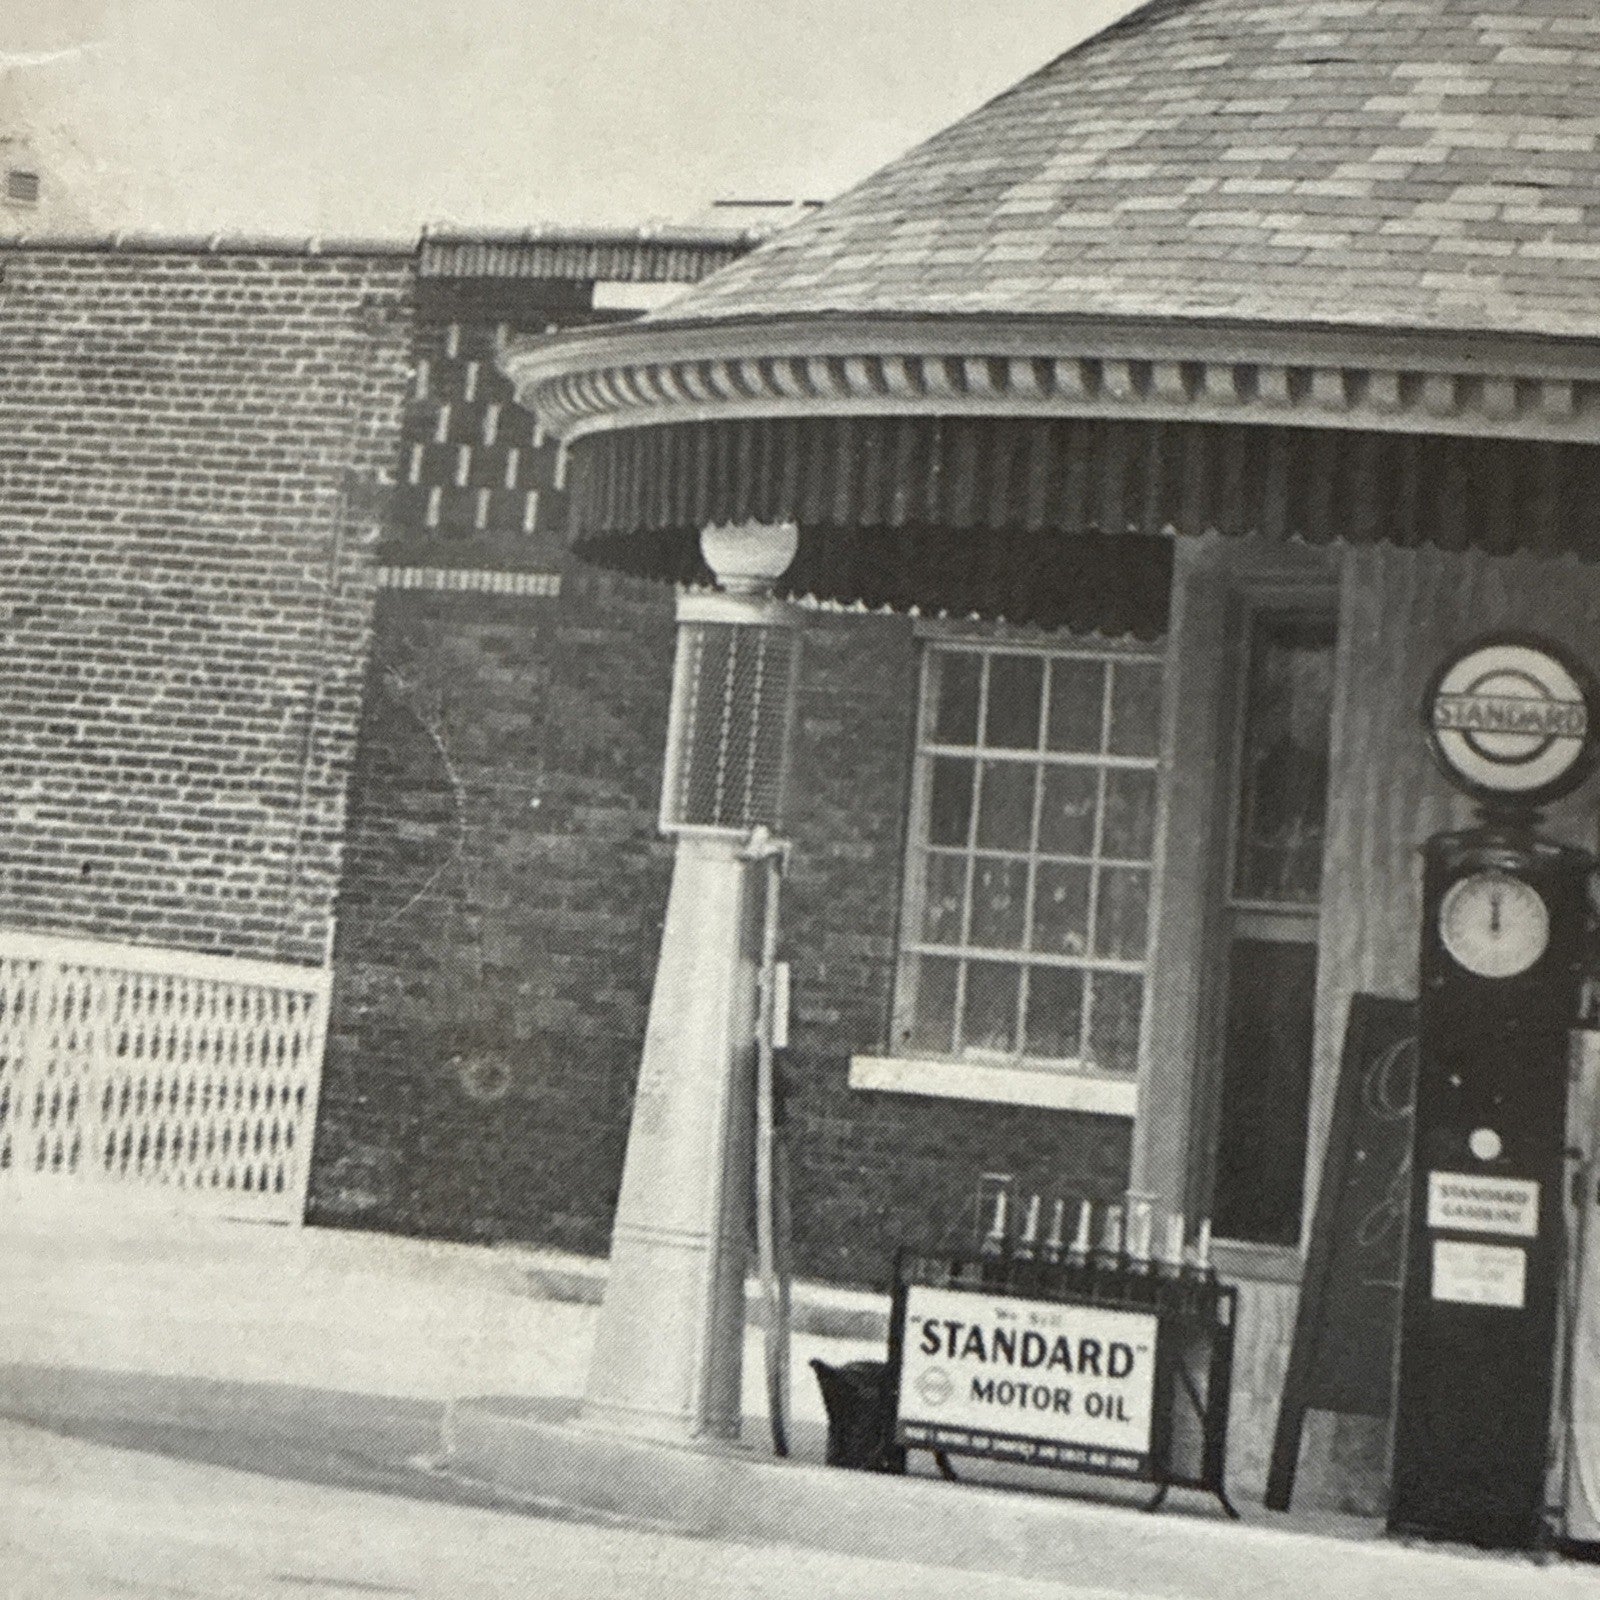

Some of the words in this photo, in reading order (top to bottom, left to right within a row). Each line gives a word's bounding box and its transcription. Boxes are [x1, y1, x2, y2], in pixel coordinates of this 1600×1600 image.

[1434, 699, 1588, 736] STANDARD
[970, 1376, 1072, 1415] MOTOR
[1084, 1392, 1132, 1422] OIL
